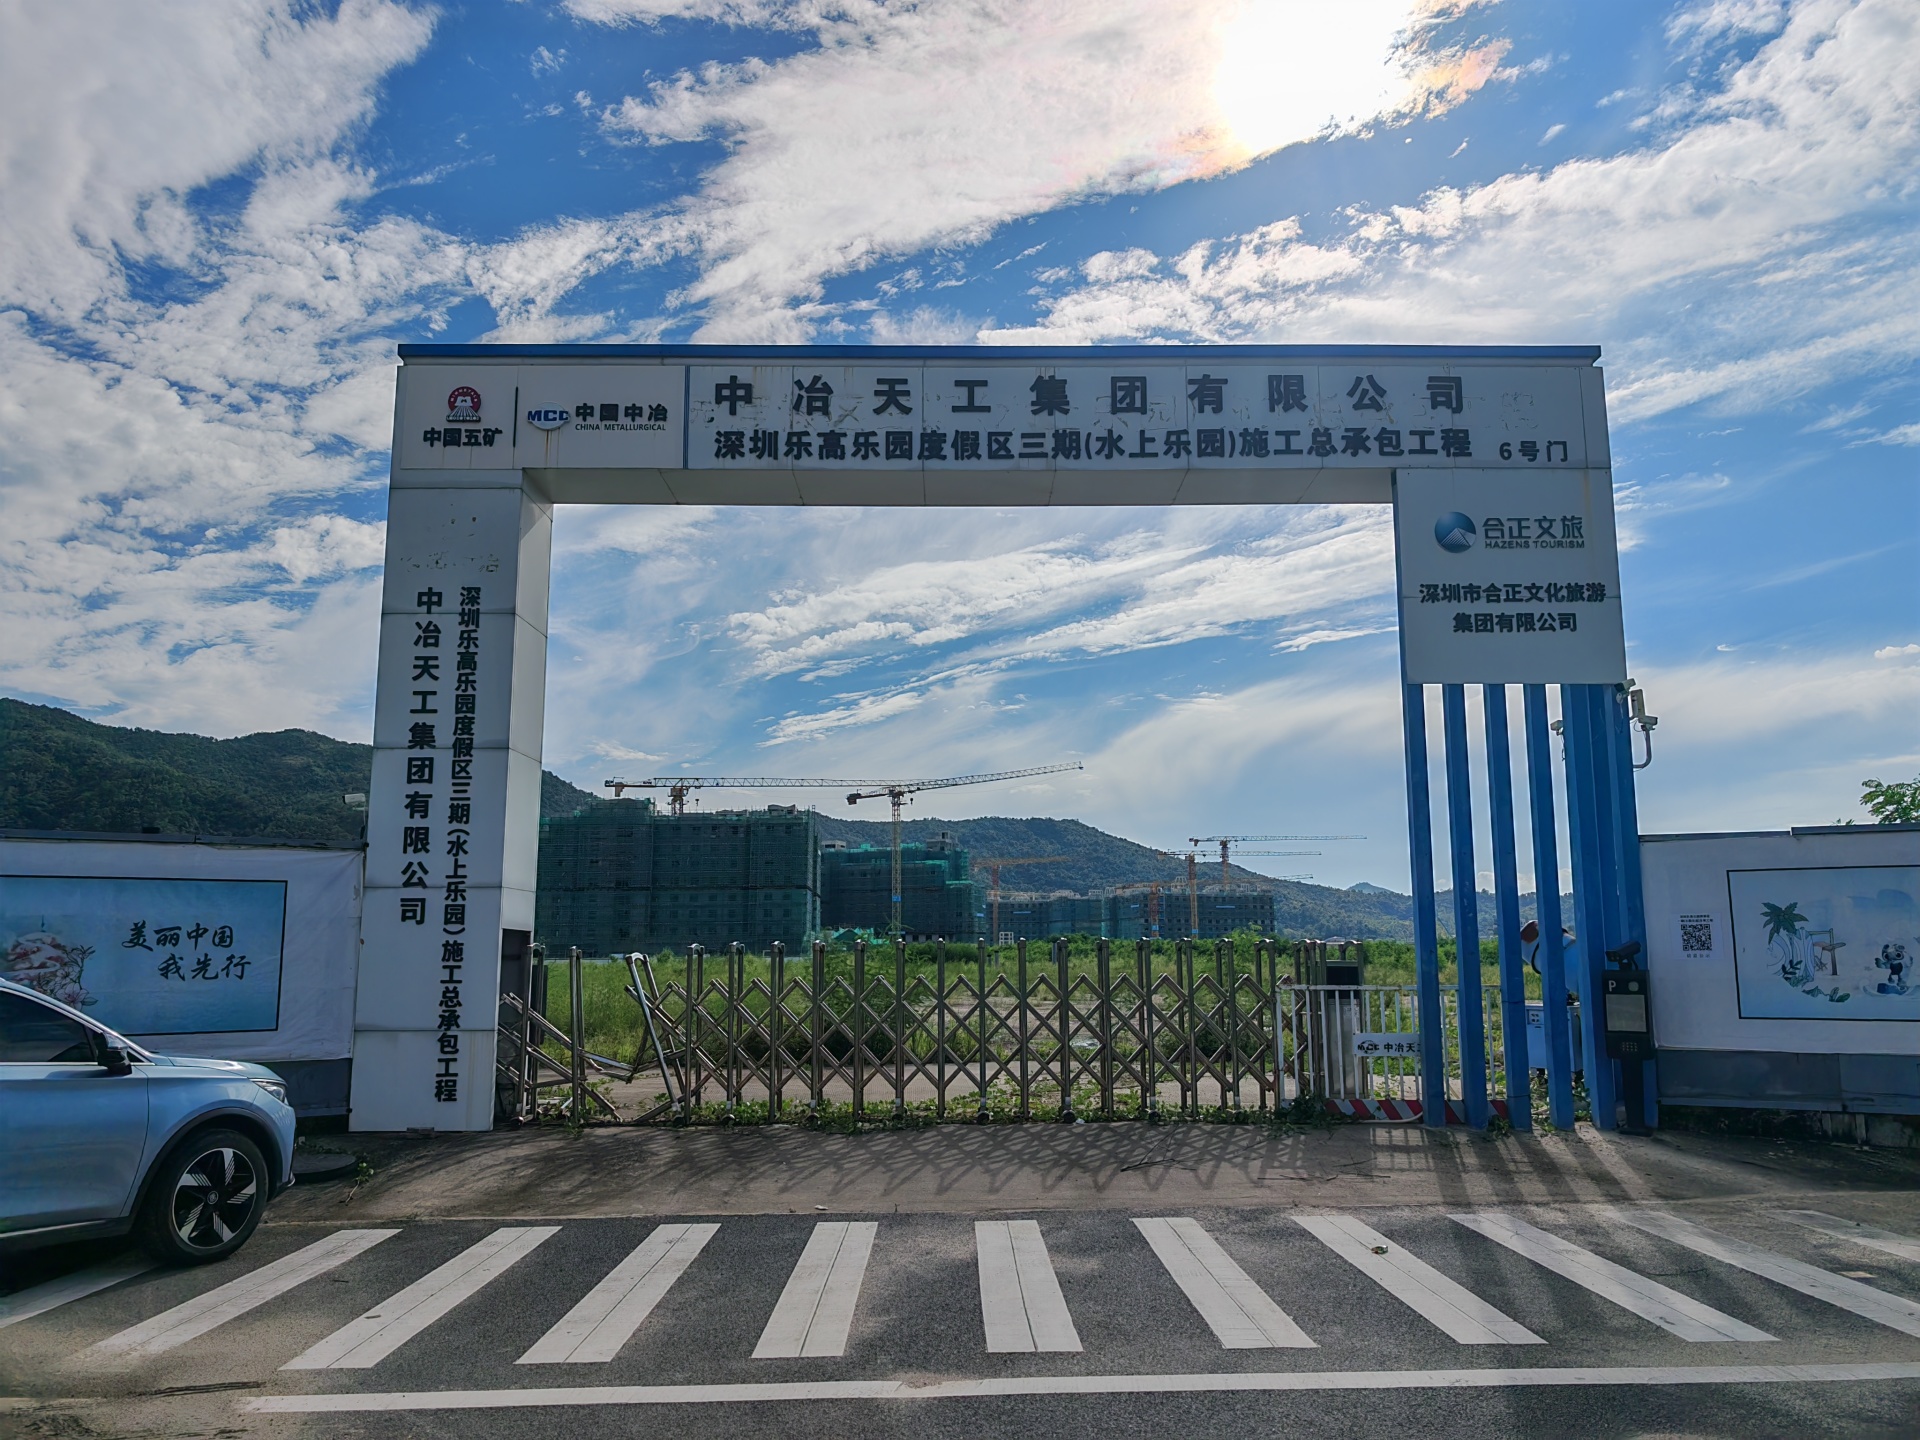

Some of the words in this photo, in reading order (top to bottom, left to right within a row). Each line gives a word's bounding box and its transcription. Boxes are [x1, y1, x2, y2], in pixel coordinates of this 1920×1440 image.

[715, 374, 1464, 416] 中冶天工集团有限公司
[575, 403, 668, 422] 中国中冶
[423, 427, 502, 447] 中国五矿
[575, 423, 600, 431] CHINA
[603, 423, 666, 431] METALLURGICAL
[714, 427, 1472, 460] 深圳乐高乐园度假区三期(水上乐园)施工总承包工程
[1499, 440, 1568, 462] 6号门
[1482, 515, 1584, 539] 合正文旅
[1485, 540, 1531, 549] HAZENS
[1533, 540, 1585, 548] TOURISM
[1419, 582, 1606, 603] 深圳市合正文化旅游
[1453, 613, 1577, 633] 集团有限公司
[400, 586, 443, 925] 中冶天工集团有限公司
[121, 920, 234, 951] 美丽中国
[157, 953, 251, 982] 我先行
[1608, 980, 1616, 992] P
